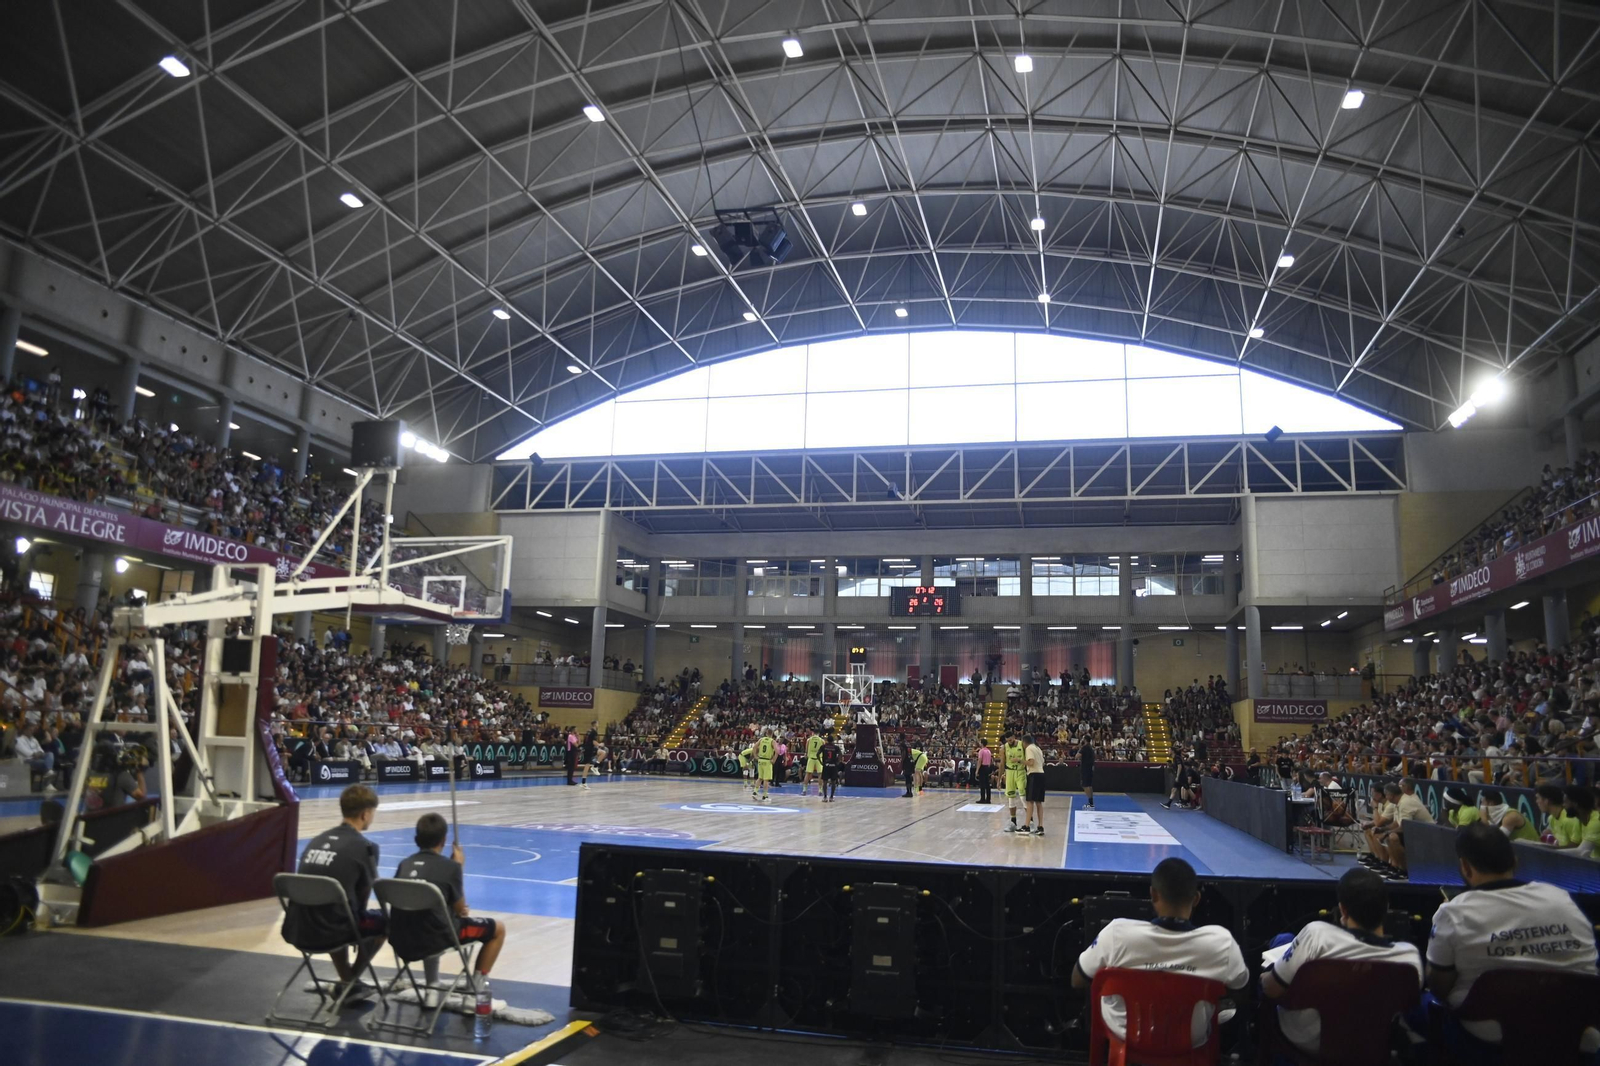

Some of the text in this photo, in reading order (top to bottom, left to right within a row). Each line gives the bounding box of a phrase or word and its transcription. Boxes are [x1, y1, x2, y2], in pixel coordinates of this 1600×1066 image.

[2, 487, 119, 521] PALACIO MUNICIPAL DEPORTES
[54, 512, 126, 542] ALEGRE
[1582, 515, 1600, 543] IM
[184, 532, 248, 562] IMDECO
[1458, 566, 1490, 594] IMDECO
[552, 691, 593, 702] IMDECO
[1272, 704, 1325, 716] IMDECO
[827, 751, 833, 759] 3
[304, 849, 338, 867] STAFF
[1490, 923, 1572, 943] ASISTENCIA
[1486, 940, 1582, 957] LOS ANGELES
